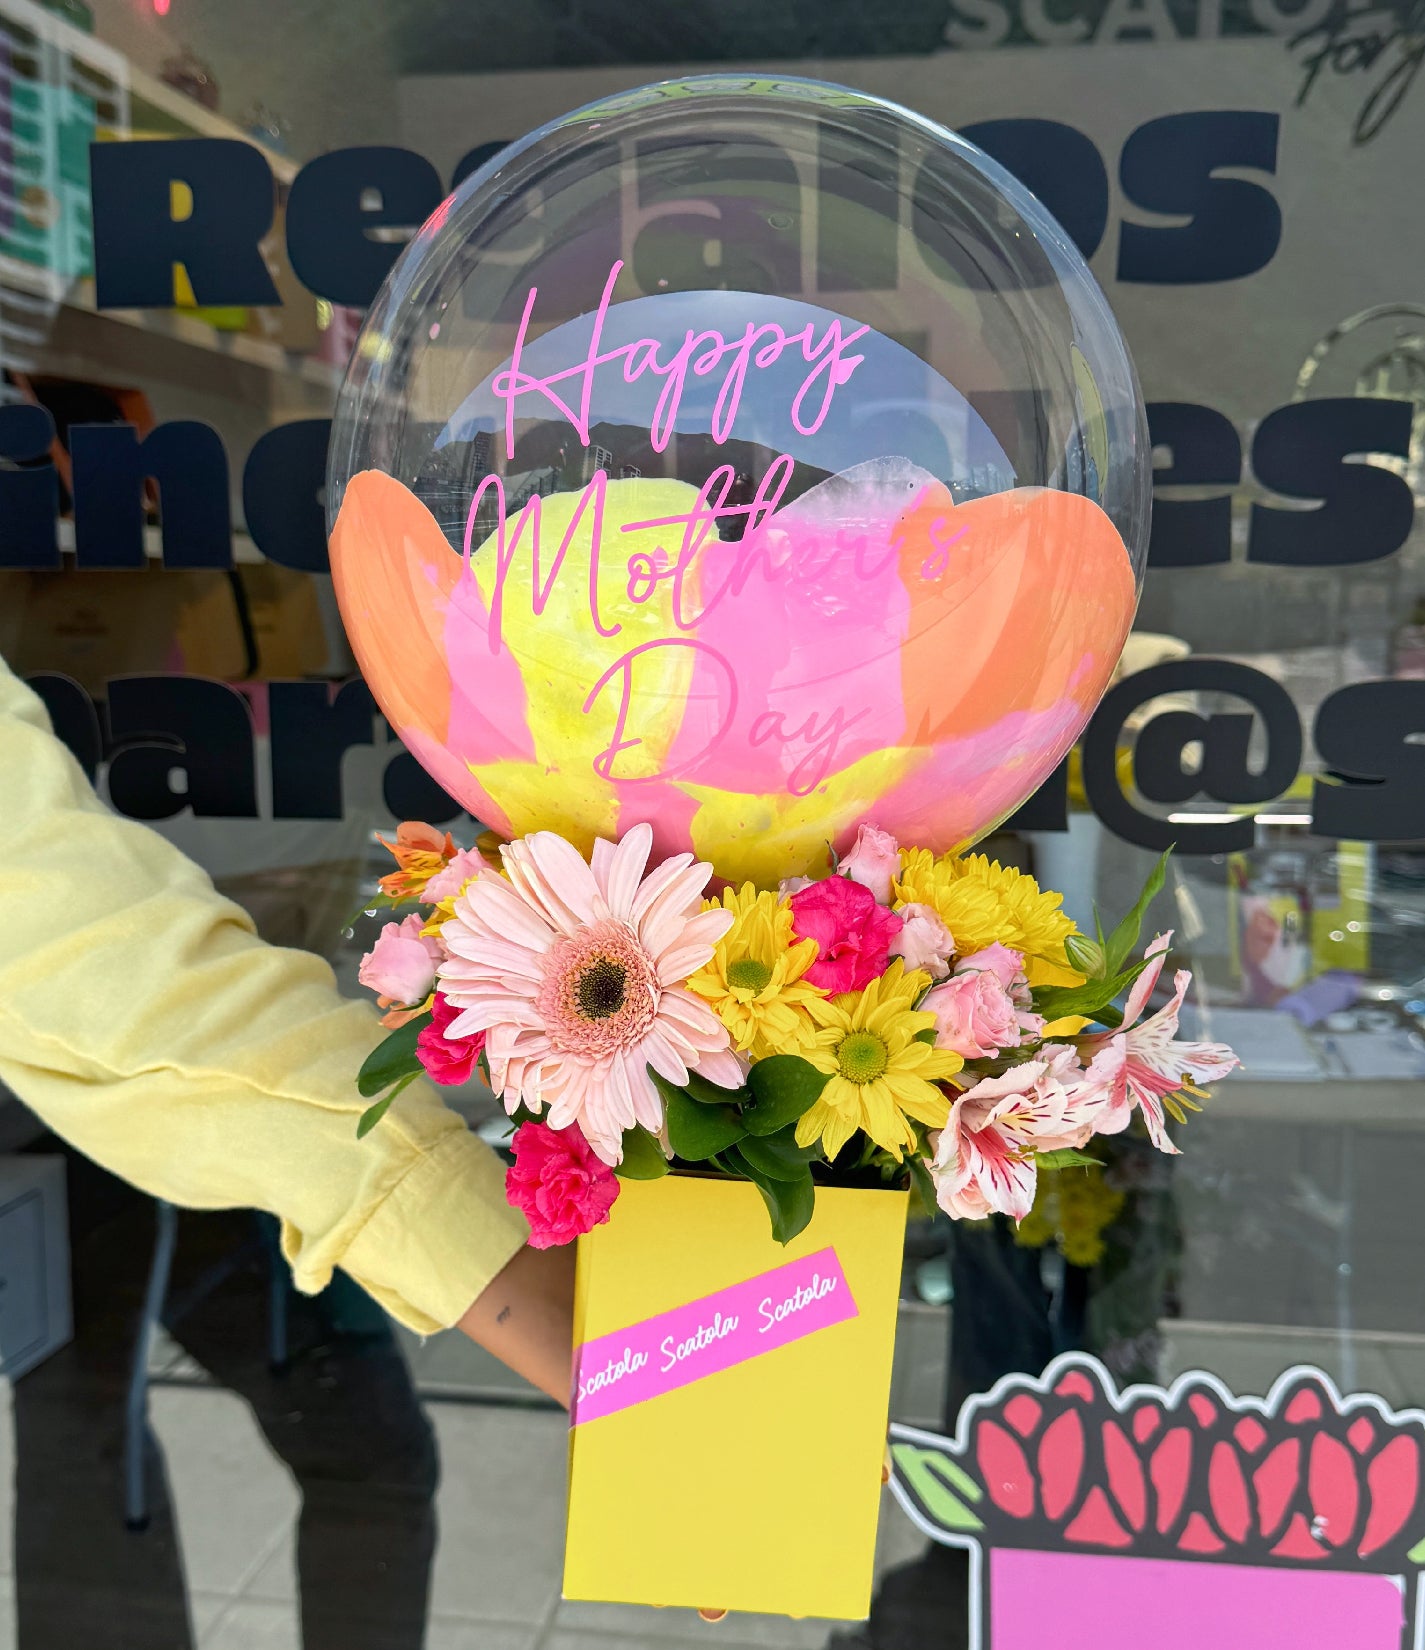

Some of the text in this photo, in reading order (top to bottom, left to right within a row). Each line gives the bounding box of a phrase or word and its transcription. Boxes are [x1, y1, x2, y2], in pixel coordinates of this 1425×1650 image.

[492, 260, 870, 460] Happy
[462, 454, 971, 655] Mother's
[582, 637, 873, 796] Day
[660, 1312, 739, 1373] Scatola
[758, 1273, 838, 1334] Scatola
